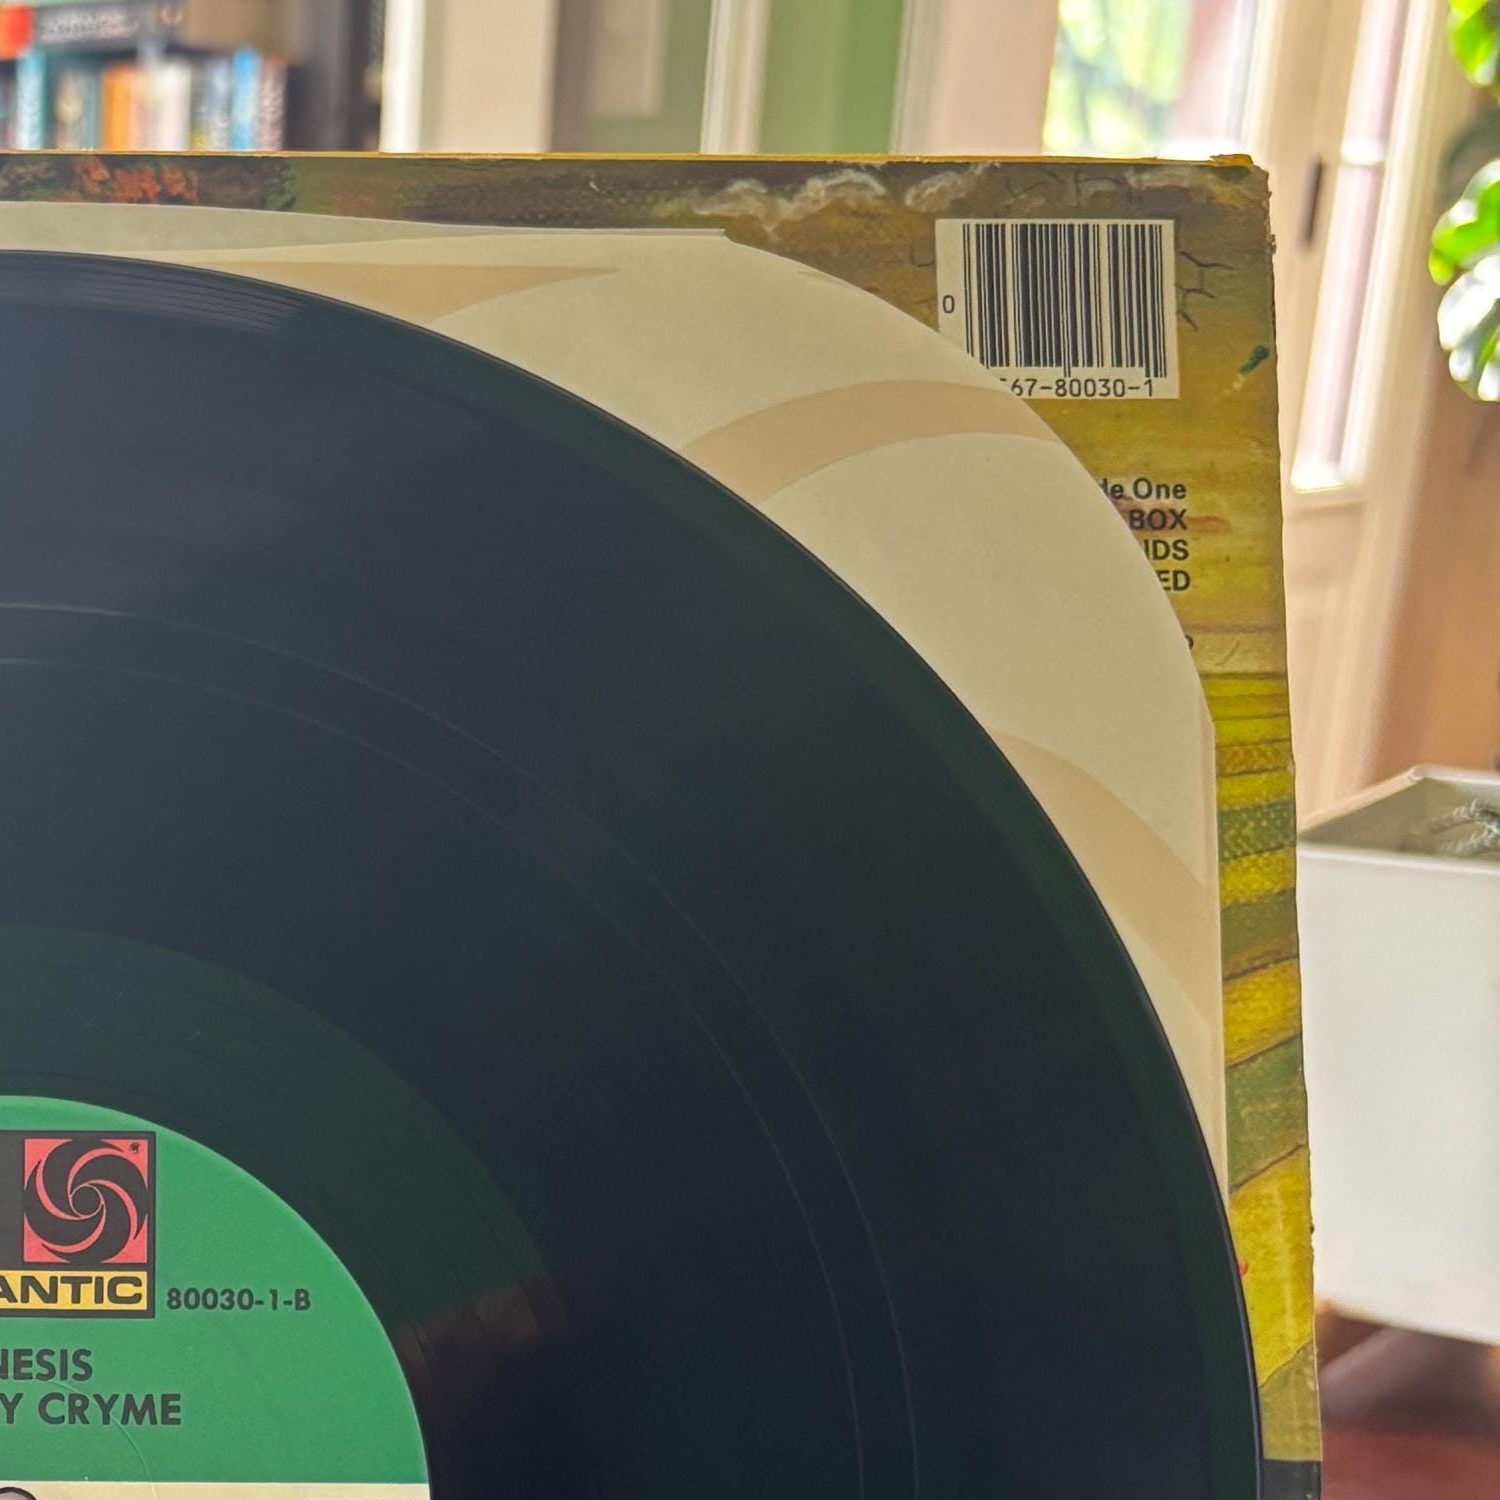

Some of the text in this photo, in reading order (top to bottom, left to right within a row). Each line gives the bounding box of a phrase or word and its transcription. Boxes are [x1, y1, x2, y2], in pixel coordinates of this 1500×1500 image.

[999, 377, 1154, 398] 67-80030-1
[1133, 477, 1187, 500] One
[1129, 508, 1187, 531] BOX
[165, 1287, 312, 1311] 80030-1-B
[35, 1392, 184, 1427] CRYME
